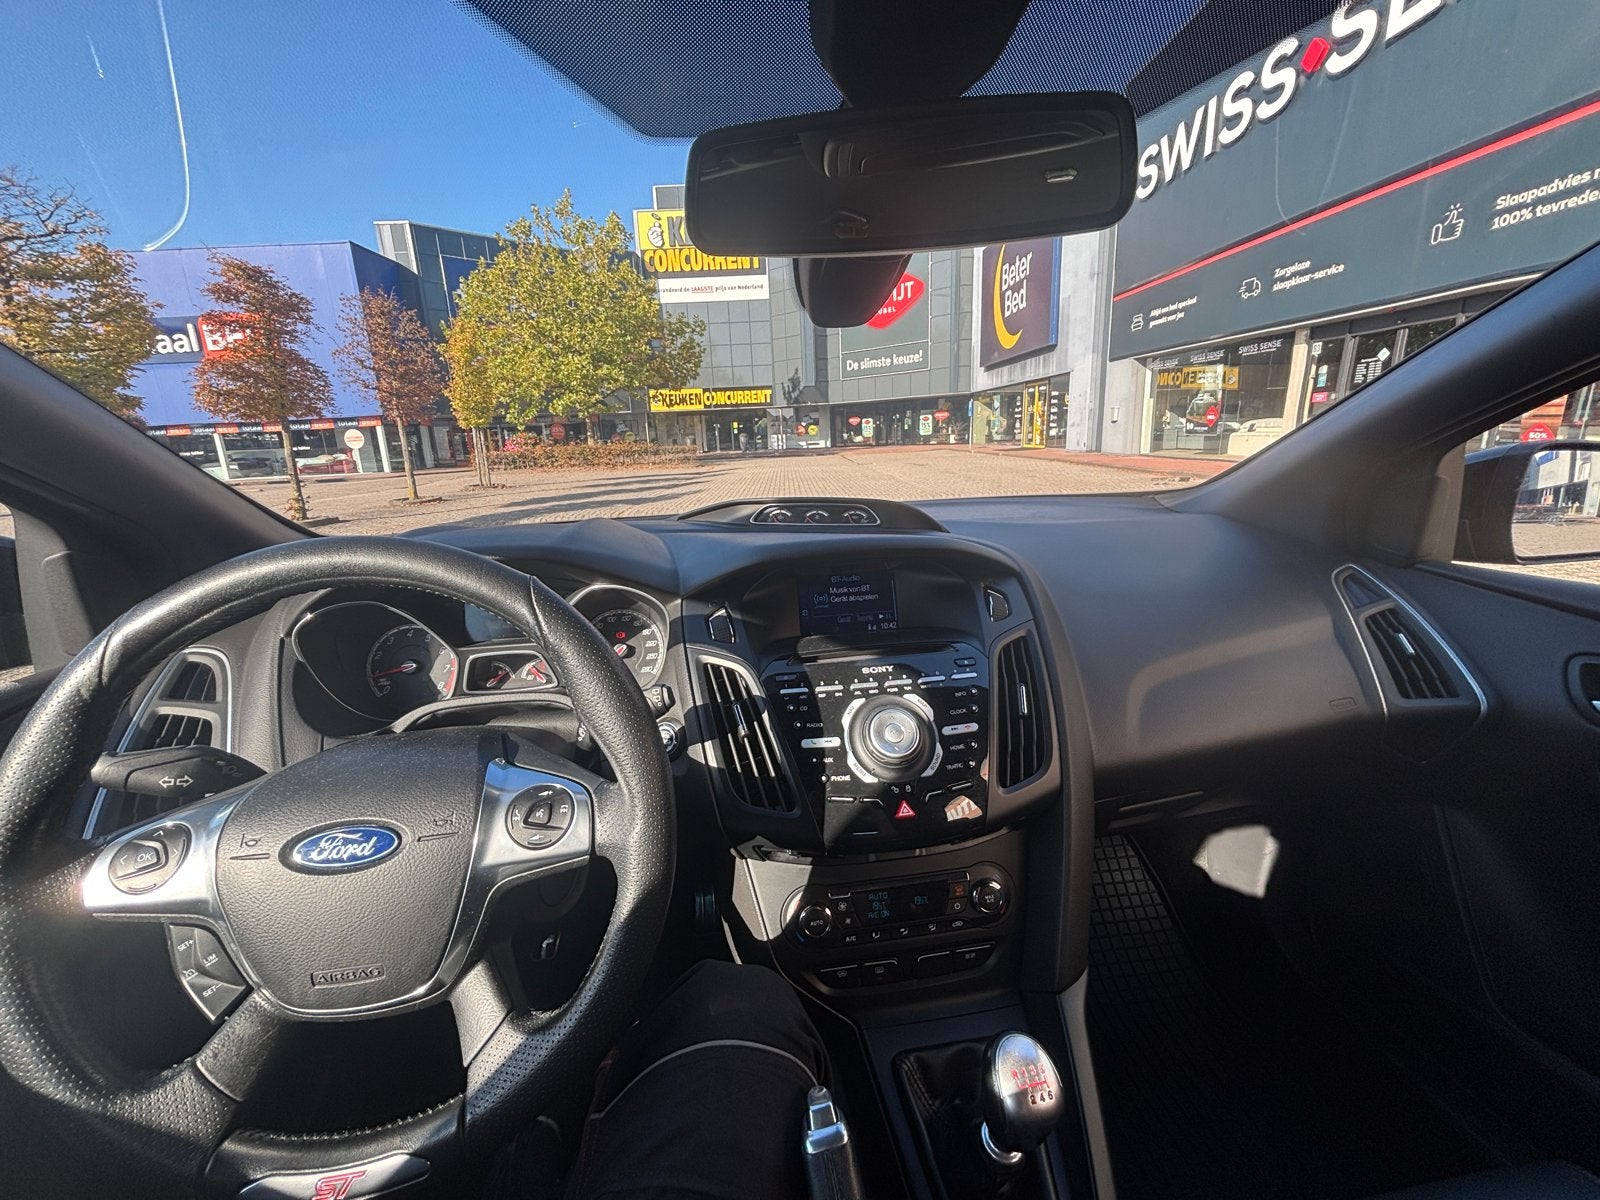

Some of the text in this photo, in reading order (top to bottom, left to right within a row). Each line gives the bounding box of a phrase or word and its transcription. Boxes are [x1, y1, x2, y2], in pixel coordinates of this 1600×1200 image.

[1136, 35, 1300, 200] SWISS
[1494, 170, 1593, 210] Slaapadvies
[1489, 189, 1600, 231] 100% tevrede
[643, 247, 760, 273] CONCURRENT
[1272, 259, 1311, 279] Zorgeloze
[1002, 250, 1033, 290] Beter
[1271, 263, 1345, 293] slaapklaar-service
[1003, 279, 1028, 319] Bed
[1239, 343, 1258, 354] SWISS
[1260, 340, 1282, 351] SENSE
[846, 350, 923, 371] De slimste keuze!
[661, 389, 773, 408] KEUKEN CONCURRENT
[1528, 432, 1548, 440] 50%
[829, 586, 848, 594] Musik
[861, 584, 870, 592] BT
[830, 593, 879, 603] Gerät abspielen
[880, 621, 897, 630] 10:42
[861, 666, 894, 675] SONY
[309, 833, 378, 861] Ford
[136, 851, 153, 863] OK
[868, 892, 888, 901] AUTO
[177, 939, 195, 952] SET+
[203, 953, 217, 965] LIM
[317, 968, 382, 985] AIRBAG
[311, 1170, 368, 1200] ST
